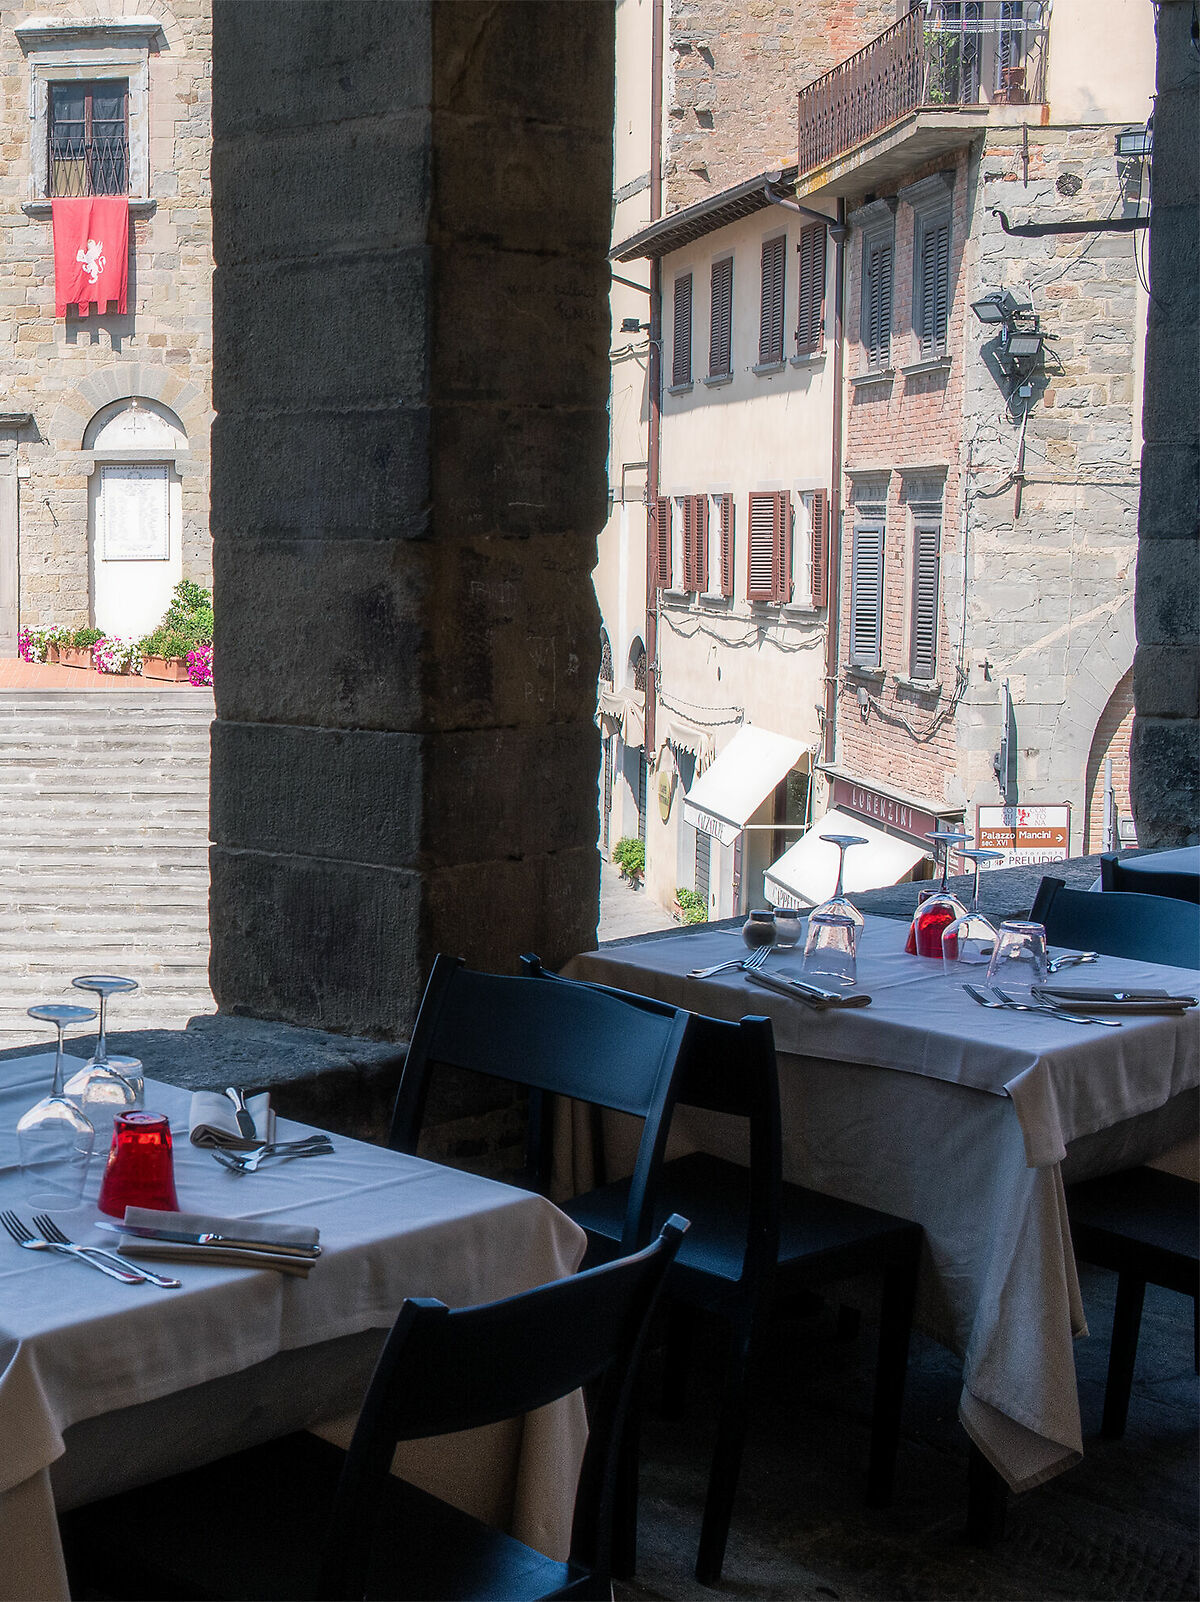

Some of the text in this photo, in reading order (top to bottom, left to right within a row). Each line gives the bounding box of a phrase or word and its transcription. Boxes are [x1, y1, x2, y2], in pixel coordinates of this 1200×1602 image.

[851, 787, 914, 829] LORENZINI
[981, 830, 1052, 840] Palazzo Mancini
[1008, 856, 1064, 865] PRELUDIO
